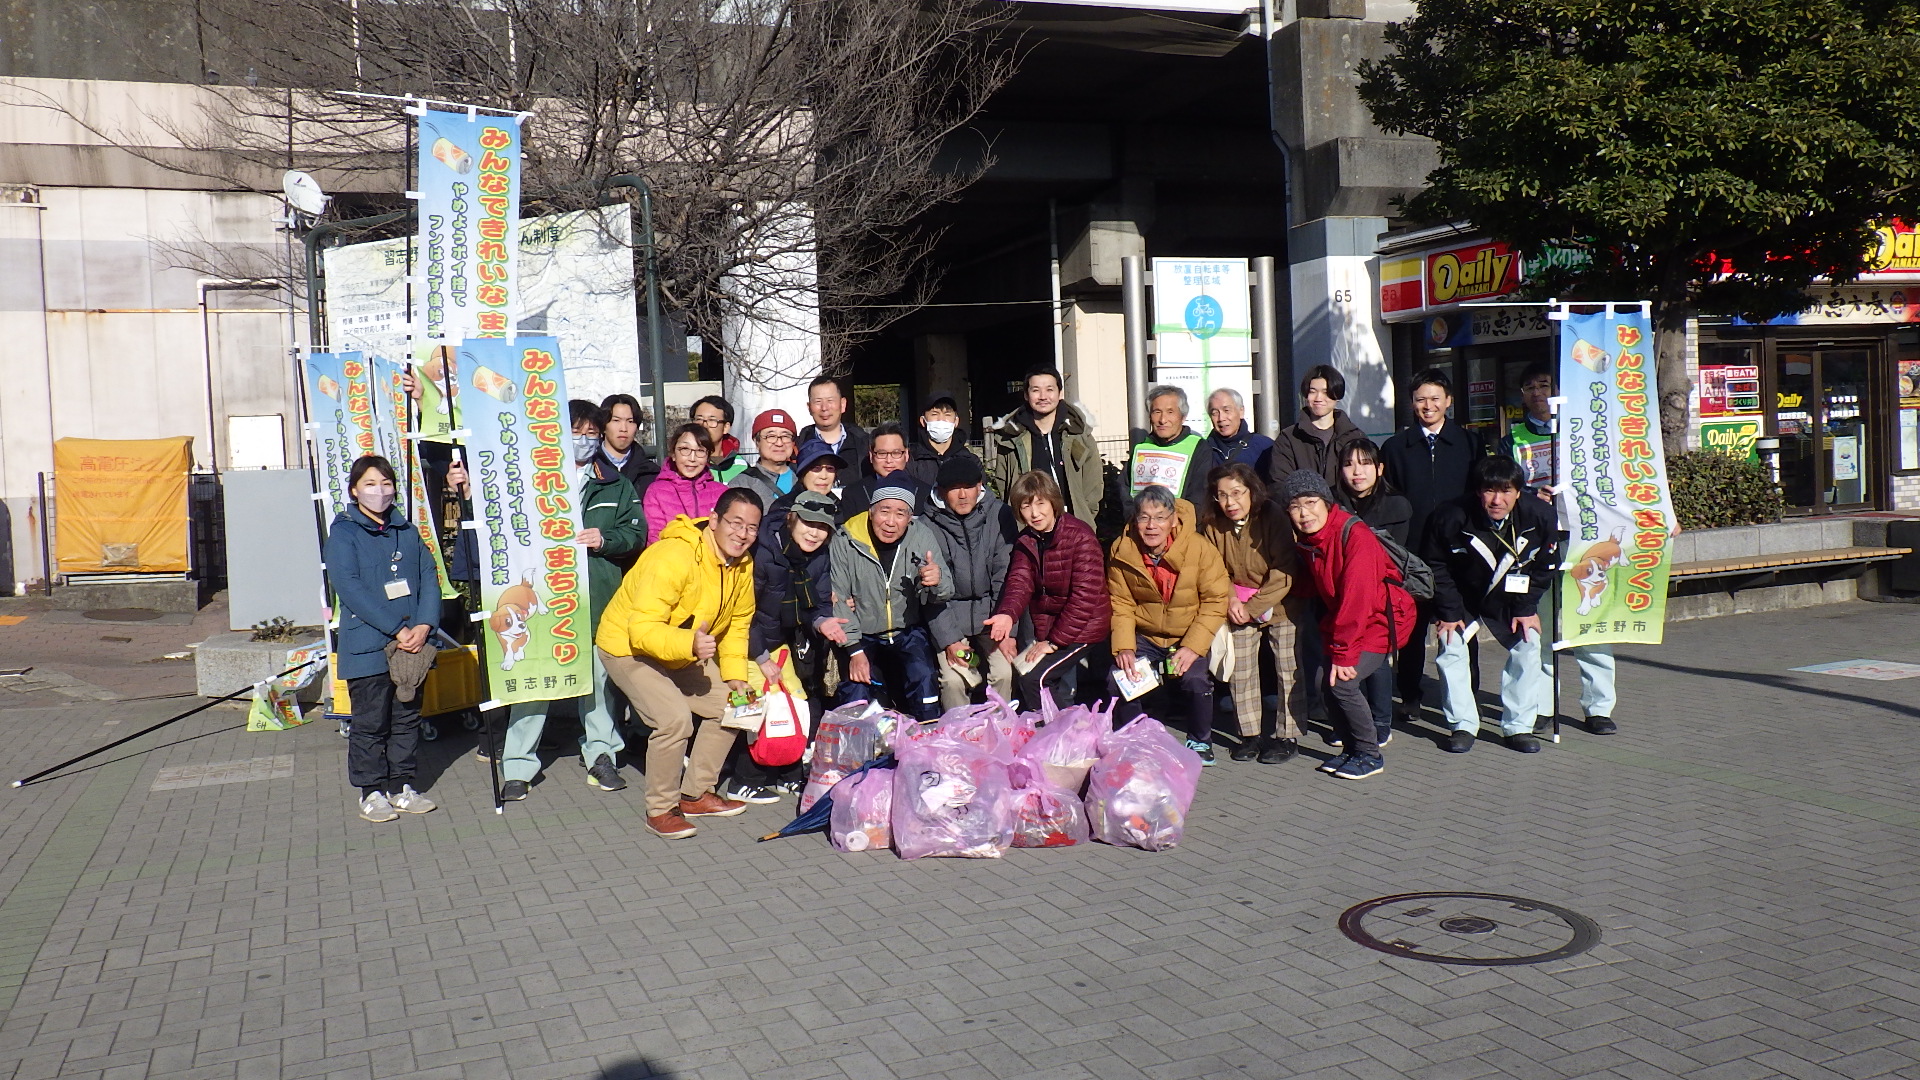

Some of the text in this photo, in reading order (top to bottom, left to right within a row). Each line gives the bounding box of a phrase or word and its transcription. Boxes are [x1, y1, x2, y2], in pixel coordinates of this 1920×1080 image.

[451, 182, 468, 307] やめようポイ捨て
[477, 126, 512, 337] みんなできれいなま
[1174, 264, 1230, 275] 放置自転車等
[1183, 276, 1221, 286] 整理区域
[1431, 248, 1514, 301] Daily
[1334, 289, 1352, 303] 65
[498, 411, 532, 547] やめようポイ捨て
[1569, 417, 1599, 541] フンは必ず後始末
[1589, 381, 1617, 507] やめようポイ捨て
[1615, 324, 1669, 613] みんなできれいなまちづくり
[1707, 428, 1740, 449] Daily
[479, 450, 510, 586] フンは必ず後始末
[520, 348, 581, 668] みんなできれいなまちづくり
[504, 673, 578, 693] 習志野市
[1579, 620, 1647, 635] 習志野市
